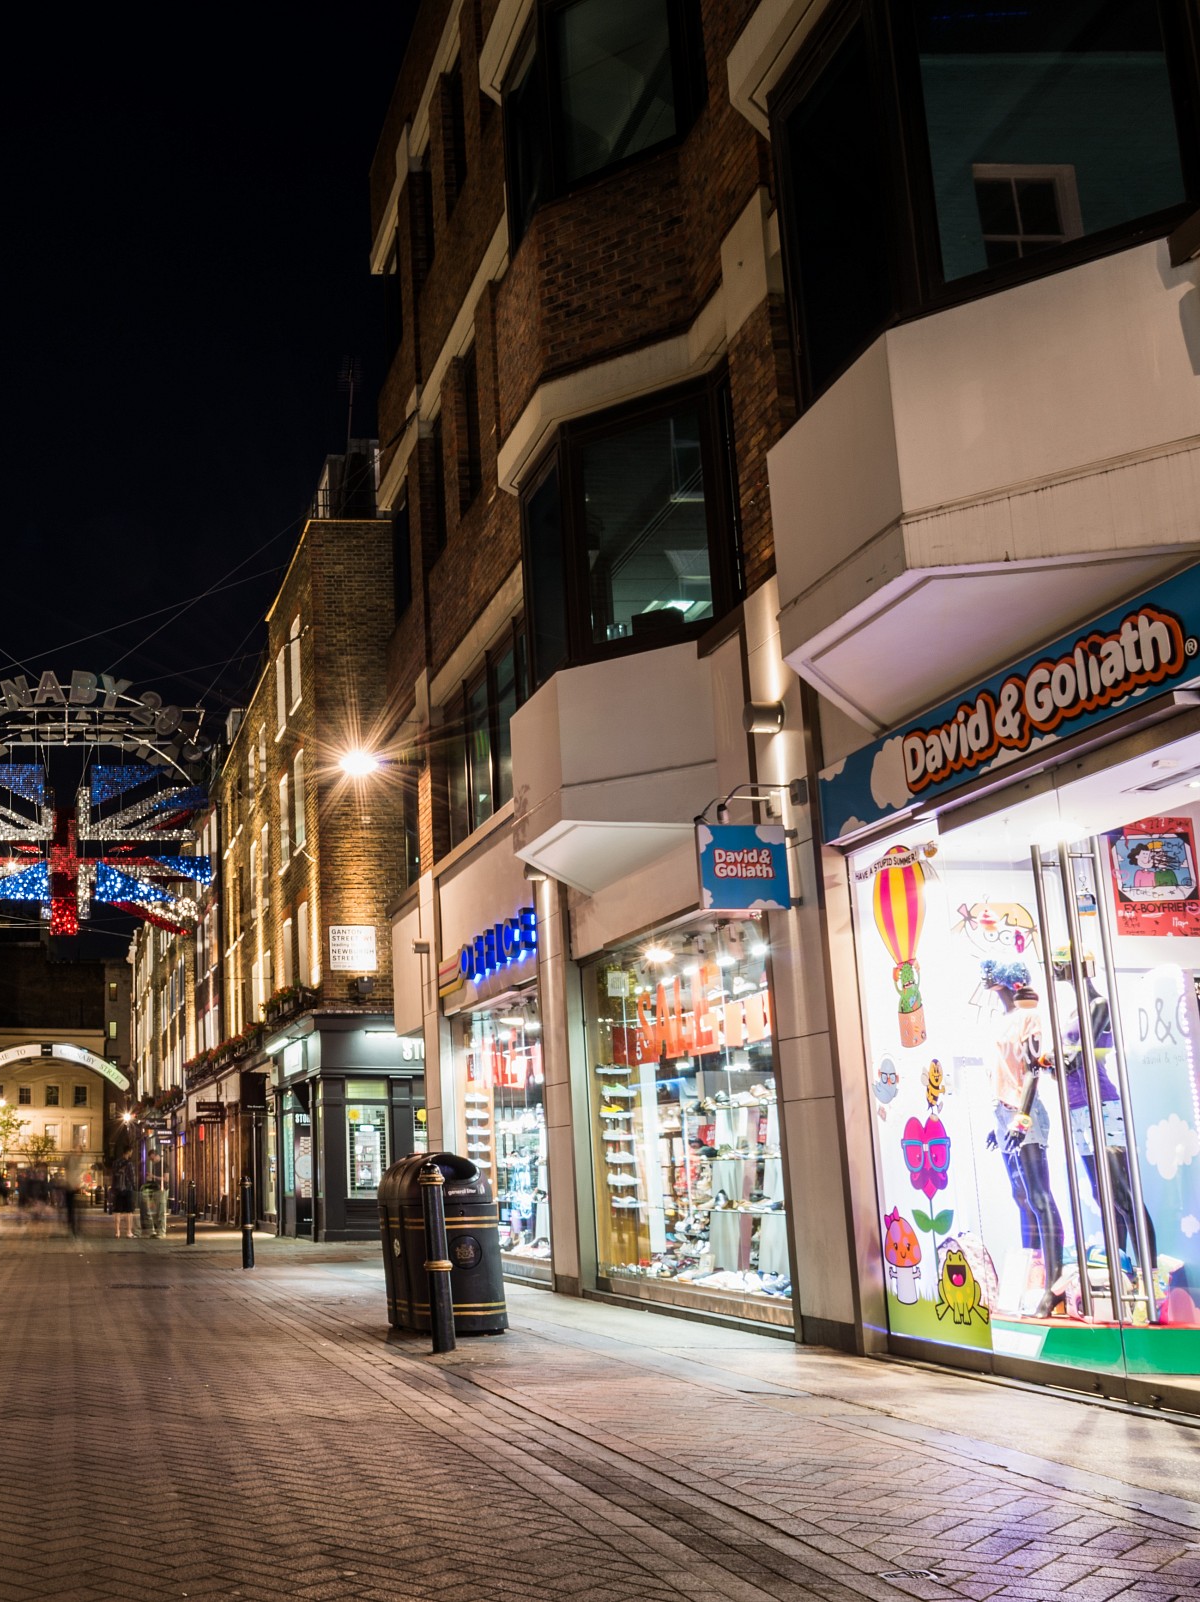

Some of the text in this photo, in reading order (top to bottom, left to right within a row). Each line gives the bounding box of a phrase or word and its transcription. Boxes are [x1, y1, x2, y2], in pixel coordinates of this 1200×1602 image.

[903, 698, 991, 784] David
[994, 683, 1021, 739] &
[1025, 614, 1172, 722] Goliath
[714, 848, 771, 864] David &
[855, 851, 917, 881] HAVE A STUPID SUMMER!
[714, 863, 774, 878] Goliath
[460, 907, 536, 981] OFFICE
[637, 965, 715, 1056] SALE
[16, 1048, 27, 1056] TO
[100, 1063, 124, 1085] STREET
[447, 1188, 466, 1196] general
